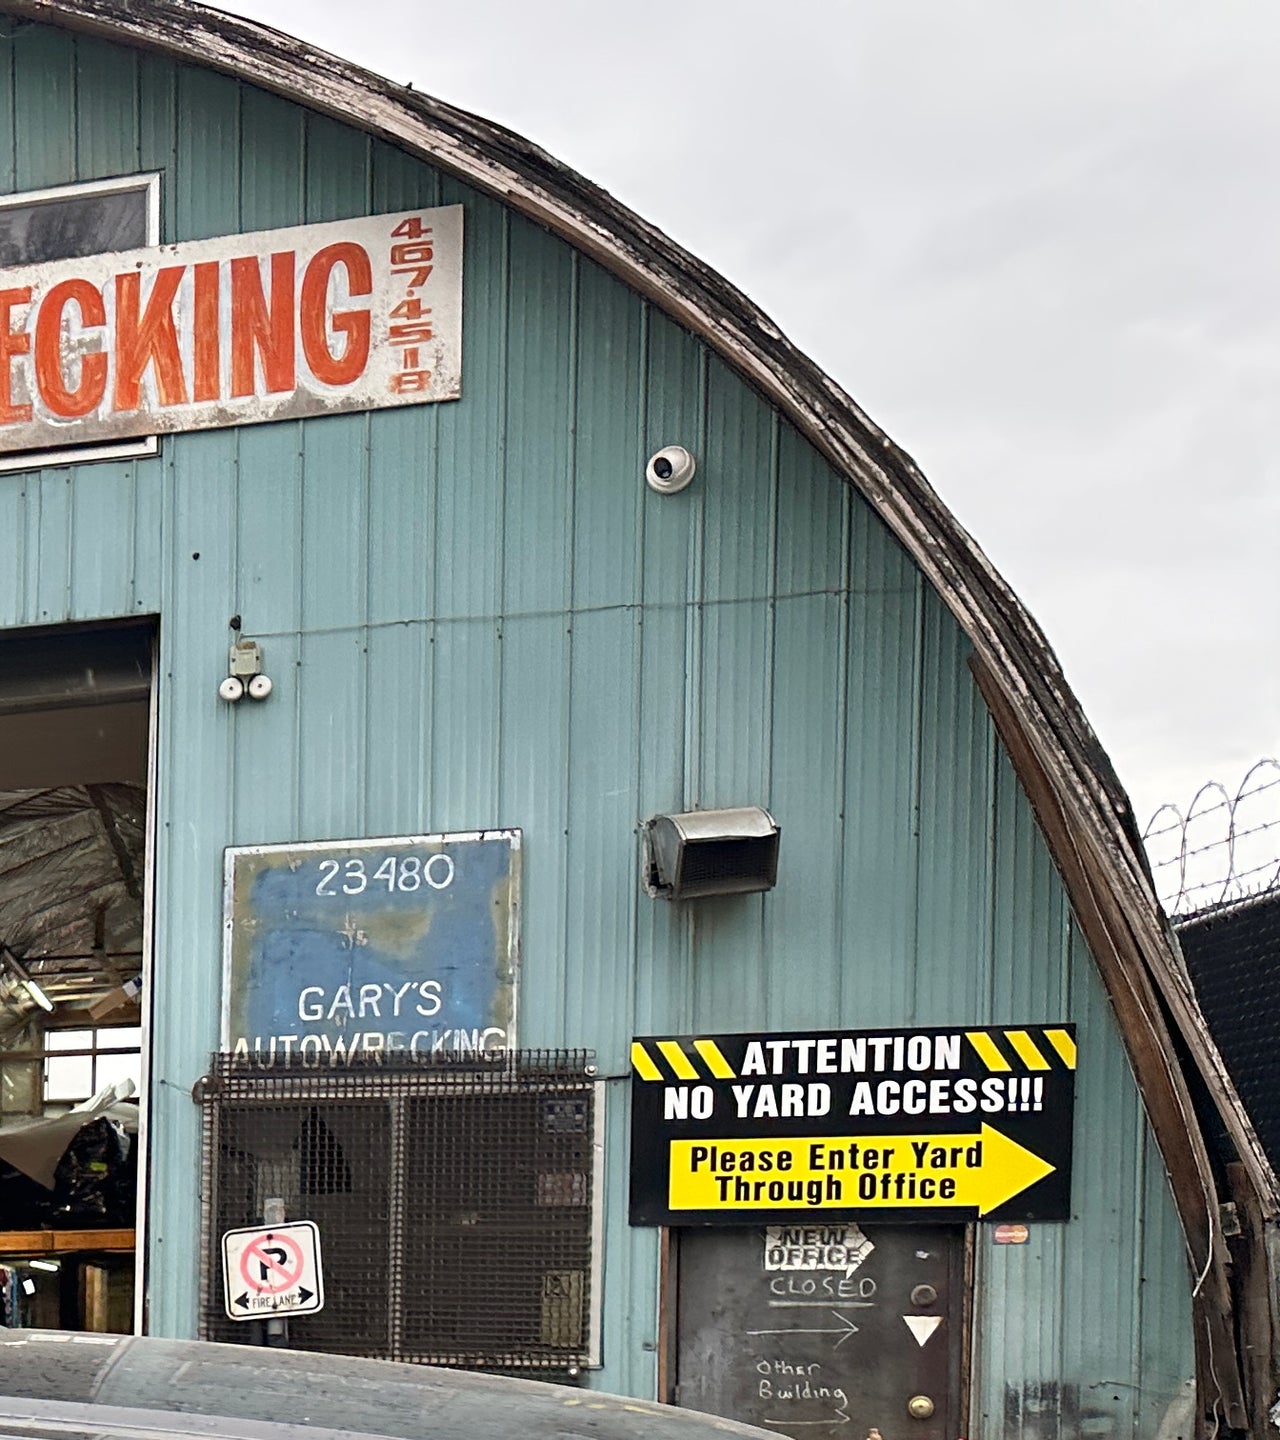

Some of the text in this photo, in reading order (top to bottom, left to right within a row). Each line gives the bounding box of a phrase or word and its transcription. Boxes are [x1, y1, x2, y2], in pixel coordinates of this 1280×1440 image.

[315, 853, 455, 896] 23480
[298, 980, 442, 1021] GARY'S
[740, 1035, 961, 1075] ATTENTION
[664, 1077, 1043, 1120] NO YARD ACCESS!!!
[690, 1140, 983, 1172] Please Enter Yard
[715, 1172, 956, 1205] Through Office
[778, 1228, 847, 1246] NEW
[767, 1246, 862, 1267] OFFICE
[251, 1296, 271, 1309] FIRE
[770, 1276, 877, 1298] CLOSED
[756, 1359, 822, 1376] Other
[758, 1379, 849, 1410] Building
